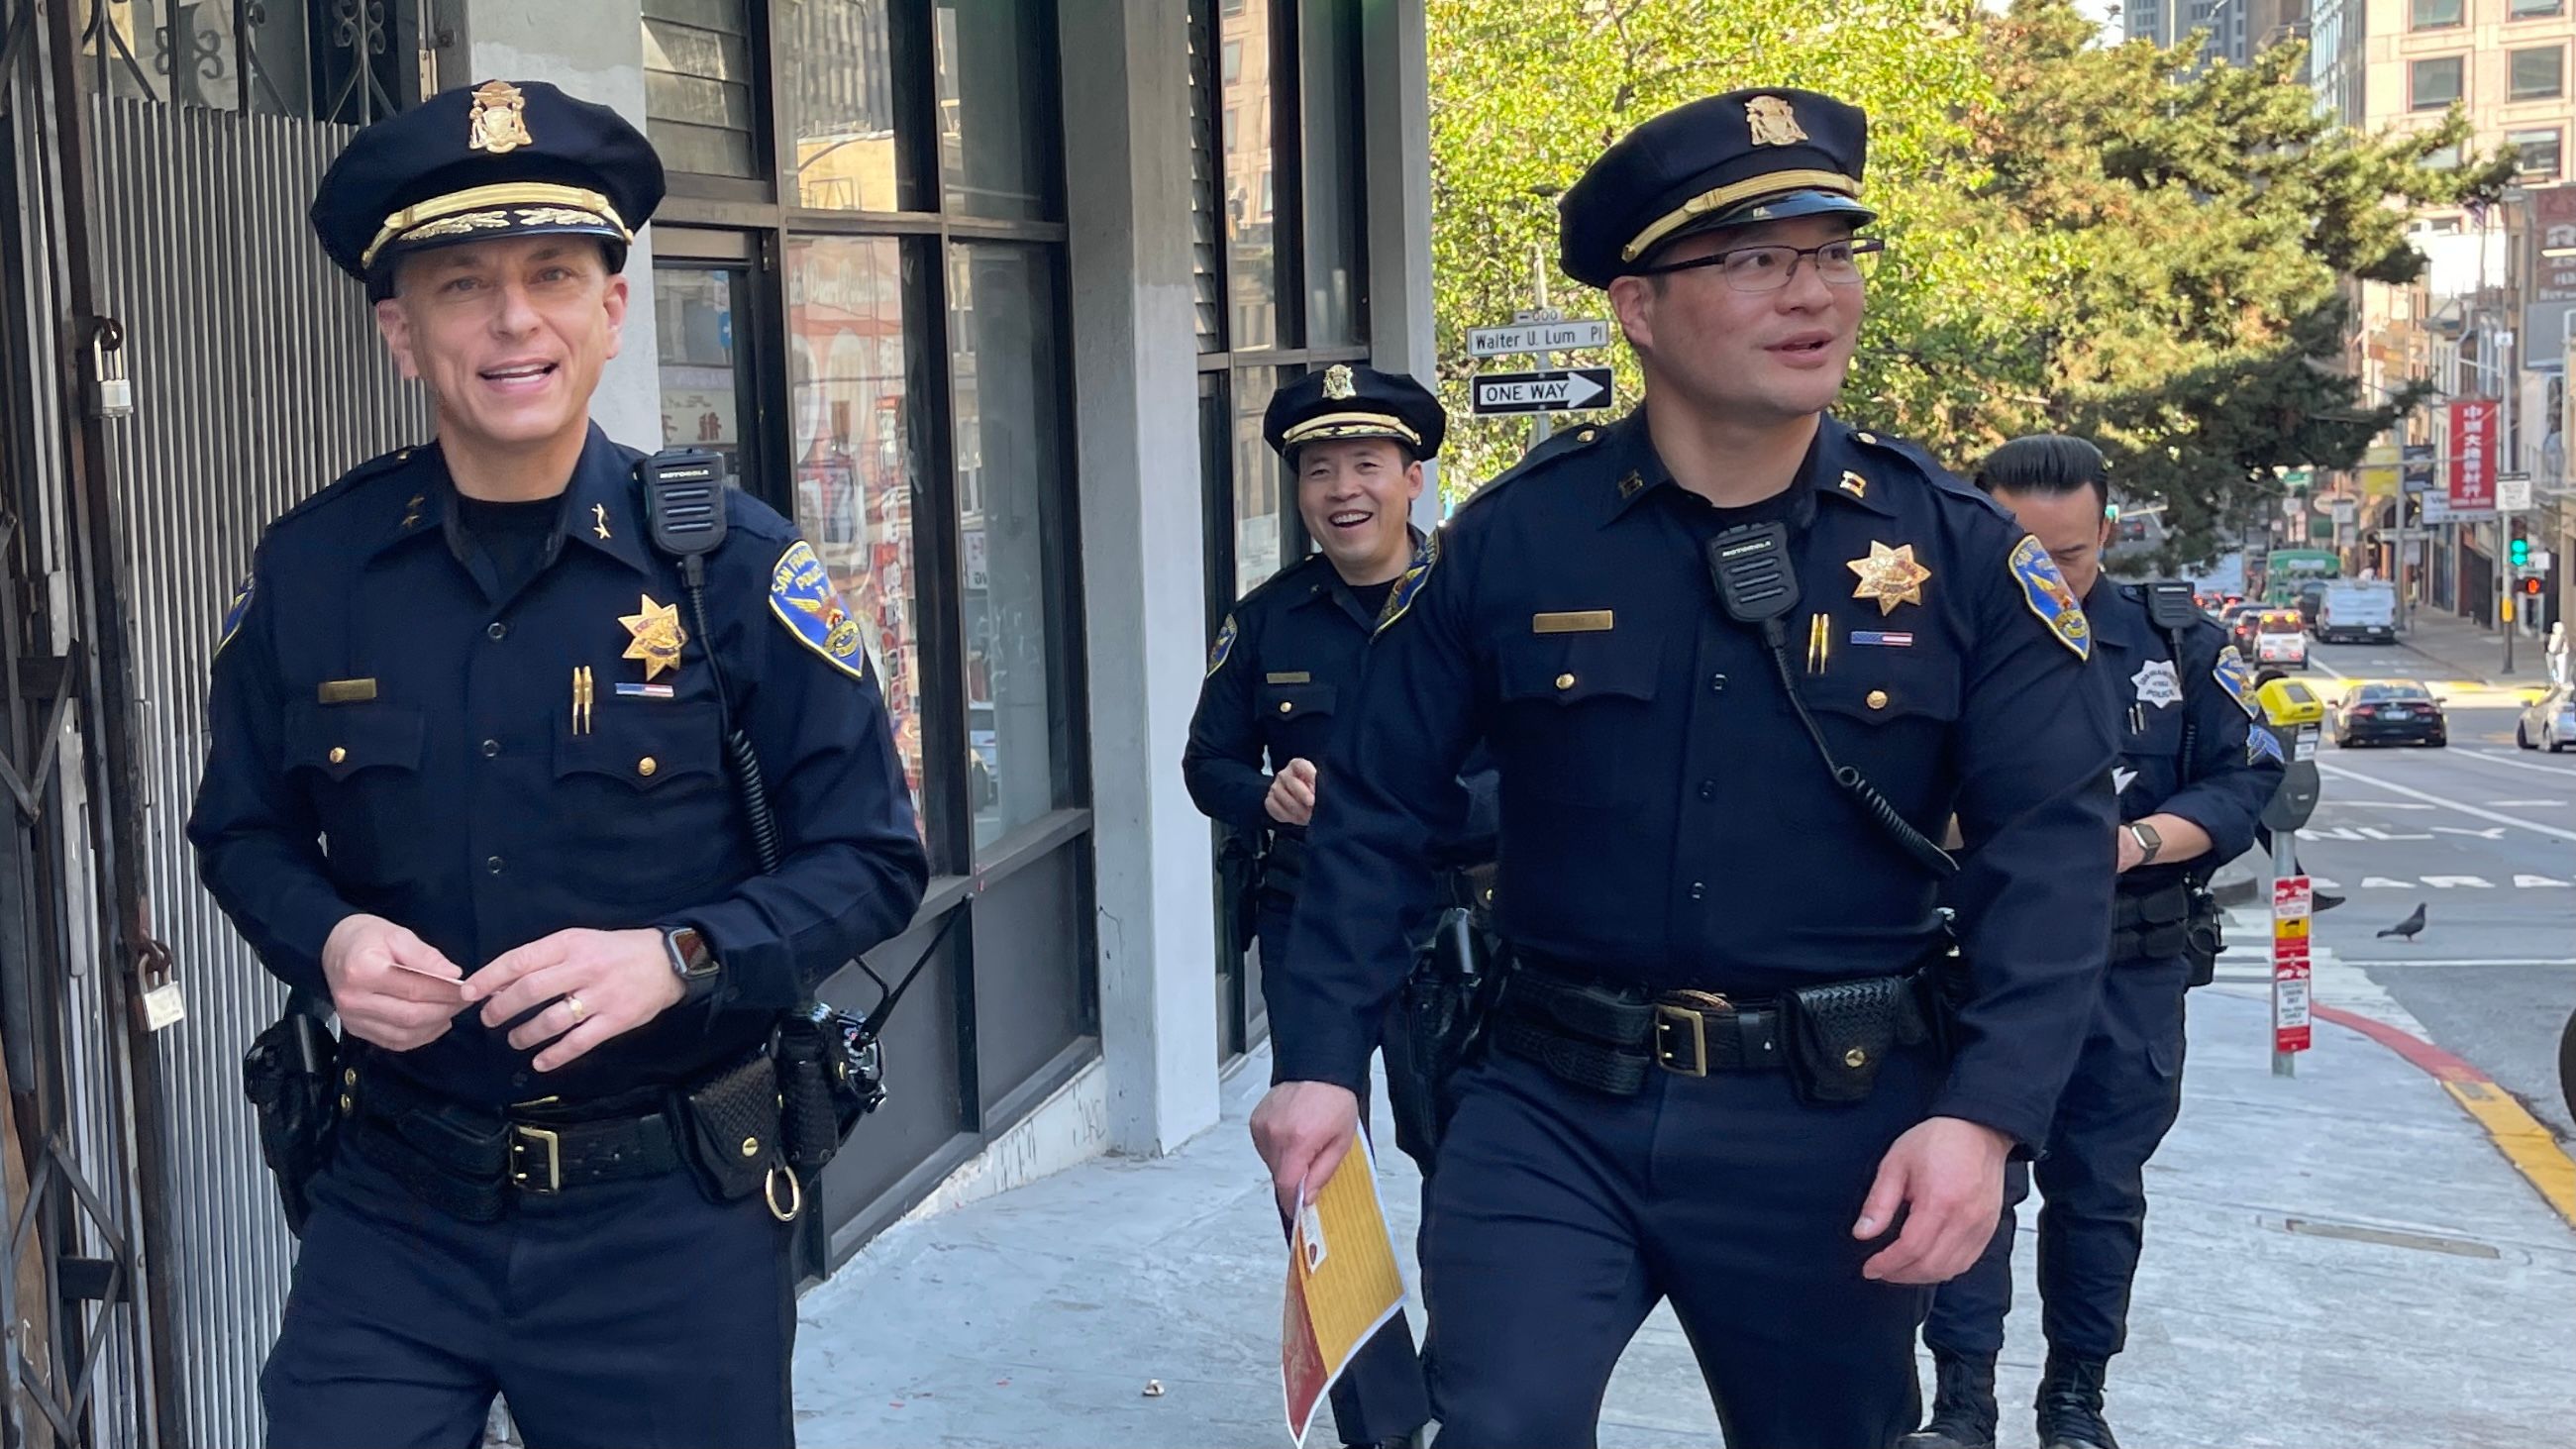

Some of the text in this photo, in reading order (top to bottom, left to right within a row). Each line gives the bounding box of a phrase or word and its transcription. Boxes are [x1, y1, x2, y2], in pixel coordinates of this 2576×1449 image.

[1476, 326, 1602, 350] Walter U. Lum Pl
[1486, 382, 1569, 402] ONE WAY
